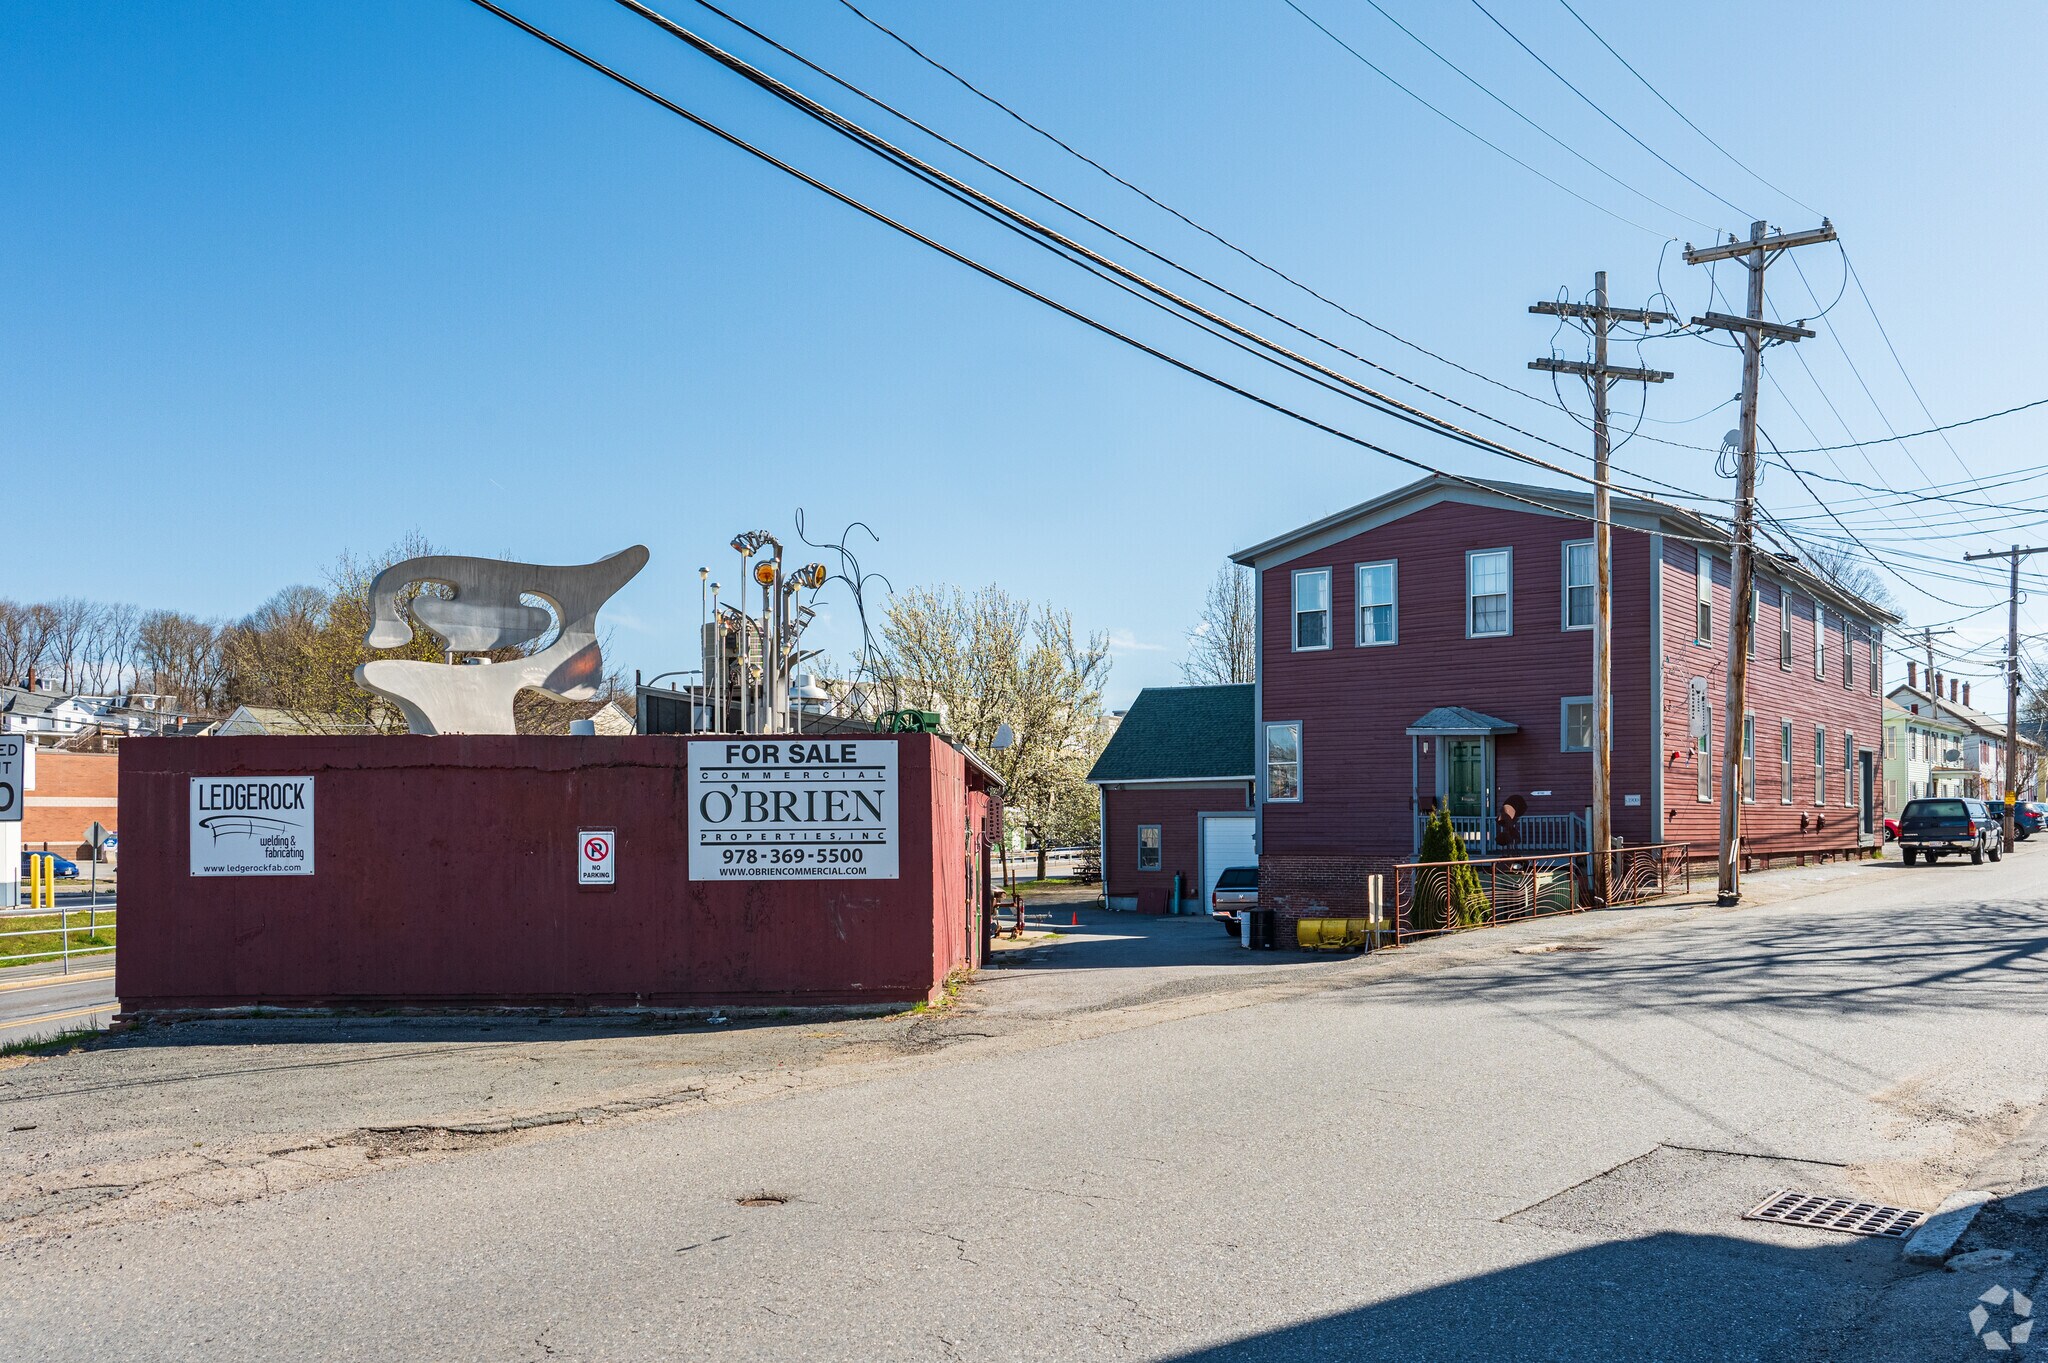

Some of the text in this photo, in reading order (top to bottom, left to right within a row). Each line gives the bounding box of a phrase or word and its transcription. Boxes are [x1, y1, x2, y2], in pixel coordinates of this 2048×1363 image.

[726, 743, 857, 764] FOR SALE
[702, 771, 884, 780] COMMERCIAL
[199, 783, 305, 811] LEDGEROCK
[700, 784, 886, 823] O'BRIEN
[260, 834, 296, 849] welding &
[850, 832, 884, 840] INC
[265, 846, 304, 861] fabricating
[203, 864, 302, 873] wwwledgerockfab.com
[719, 867, 867, 876] WWW.OBRIENCOMMERCIAL.COM
